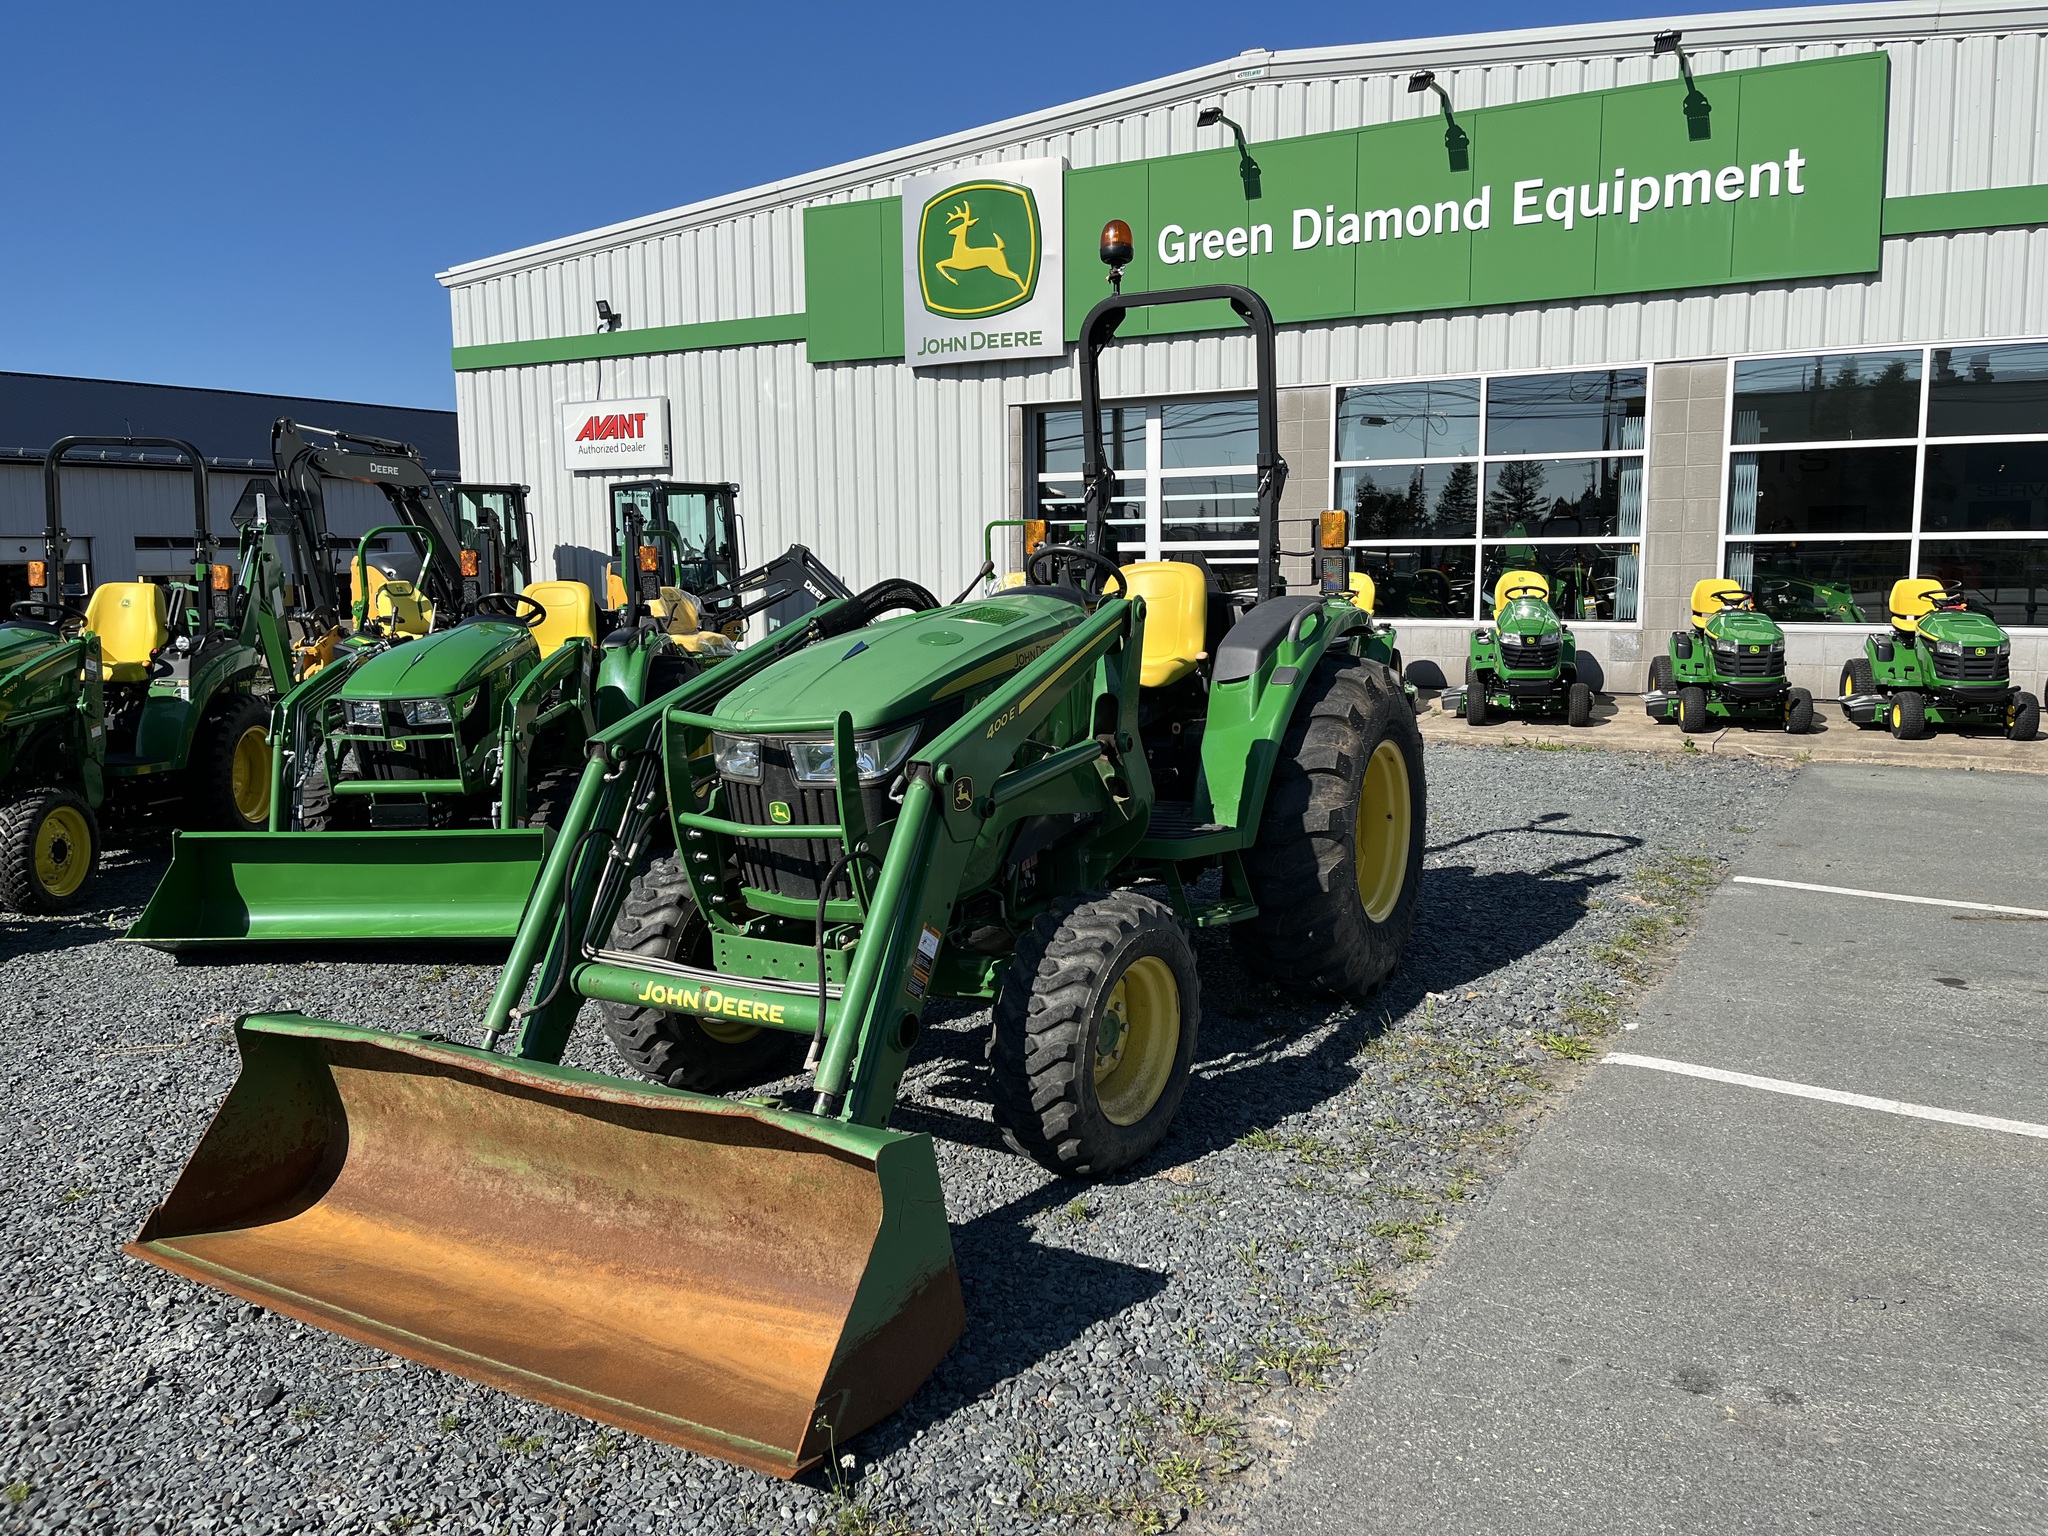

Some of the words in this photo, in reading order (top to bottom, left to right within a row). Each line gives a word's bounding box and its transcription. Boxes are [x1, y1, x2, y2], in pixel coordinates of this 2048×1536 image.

[1157, 222, 1273, 266] Green
[1291, 186, 1490, 253] Diamond
[1512, 148, 1806, 232] Equipment
[918, 335, 968, 356] JOHN
[971, 330, 1042, 350] DEERE
[575, 412, 646, 442] AVANT
[578, 442, 619, 454] Authorized
[620, 441, 647, 453] Dealer
[370, 462, 399, 475] DEERE
[1014, 650, 1036, 668] JOHN
[638, 980, 700, 1009] JOHN
[705, 989, 786, 1024] DEERE
